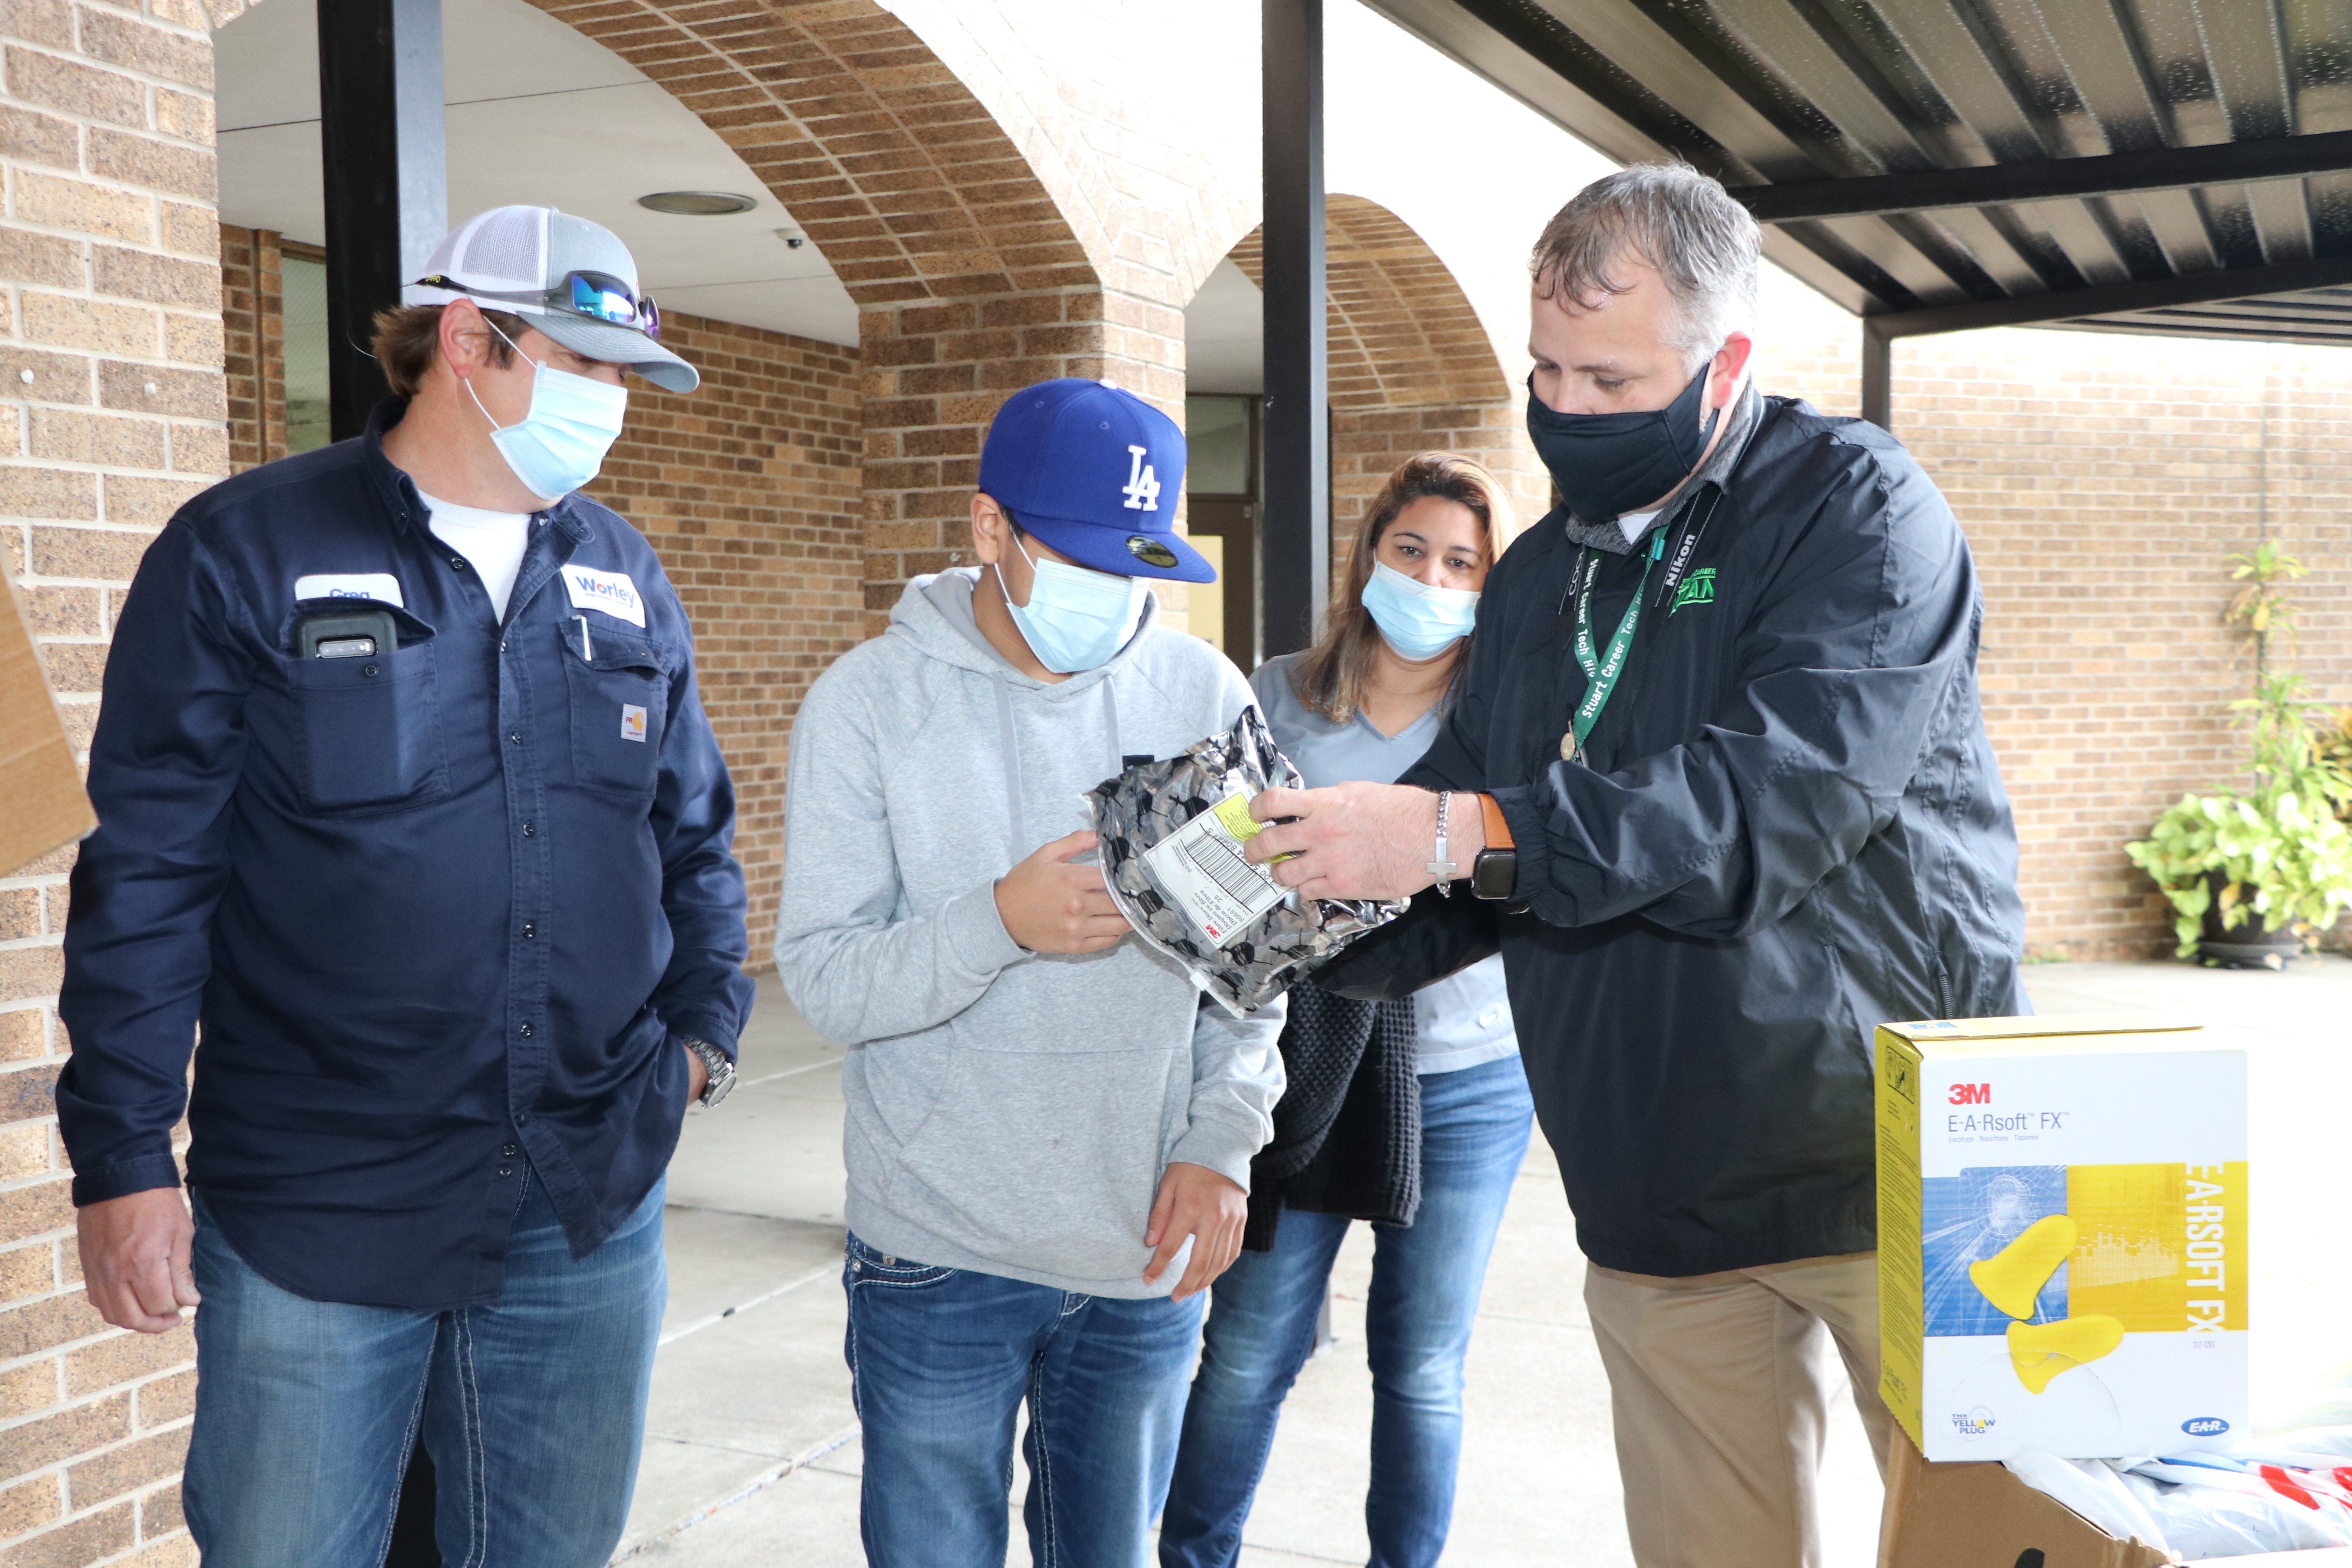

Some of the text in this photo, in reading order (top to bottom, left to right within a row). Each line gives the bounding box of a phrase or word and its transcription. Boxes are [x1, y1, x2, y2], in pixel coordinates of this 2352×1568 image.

[1122, 445, 1160, 511] LA
[1665, 534, 1696, 586] Nikon
[1583, 558, 1599, 590] Stuart
[575, 576, 634, 608] Worley
[1578, 592, 1590, 624] Career
[1578, 629, 1589, 655] Tech
[1582, 610, 1638, 719] Stuart Career Tech
[1184, 865, 1192, 873] 50
[1259, 869, 1270, 880] 00
[1193, 892, 1206, 904] fibre
[1199, 889, 1214, 904] Fibra
[1199, 906, 1213, 920] Discs
[1213, 894, 1245, 922] 80661 25
[1220, 910, 1238, 925] Discos
[1211, 911, 1232, 929] Disques
[1212, 920, 1227, 934] Fibre
[1205, 924, 1221, 939] 3M
[1948, 1083, 1990, 1105] 3M
[2186, 1299, 2225, 1332] FX
